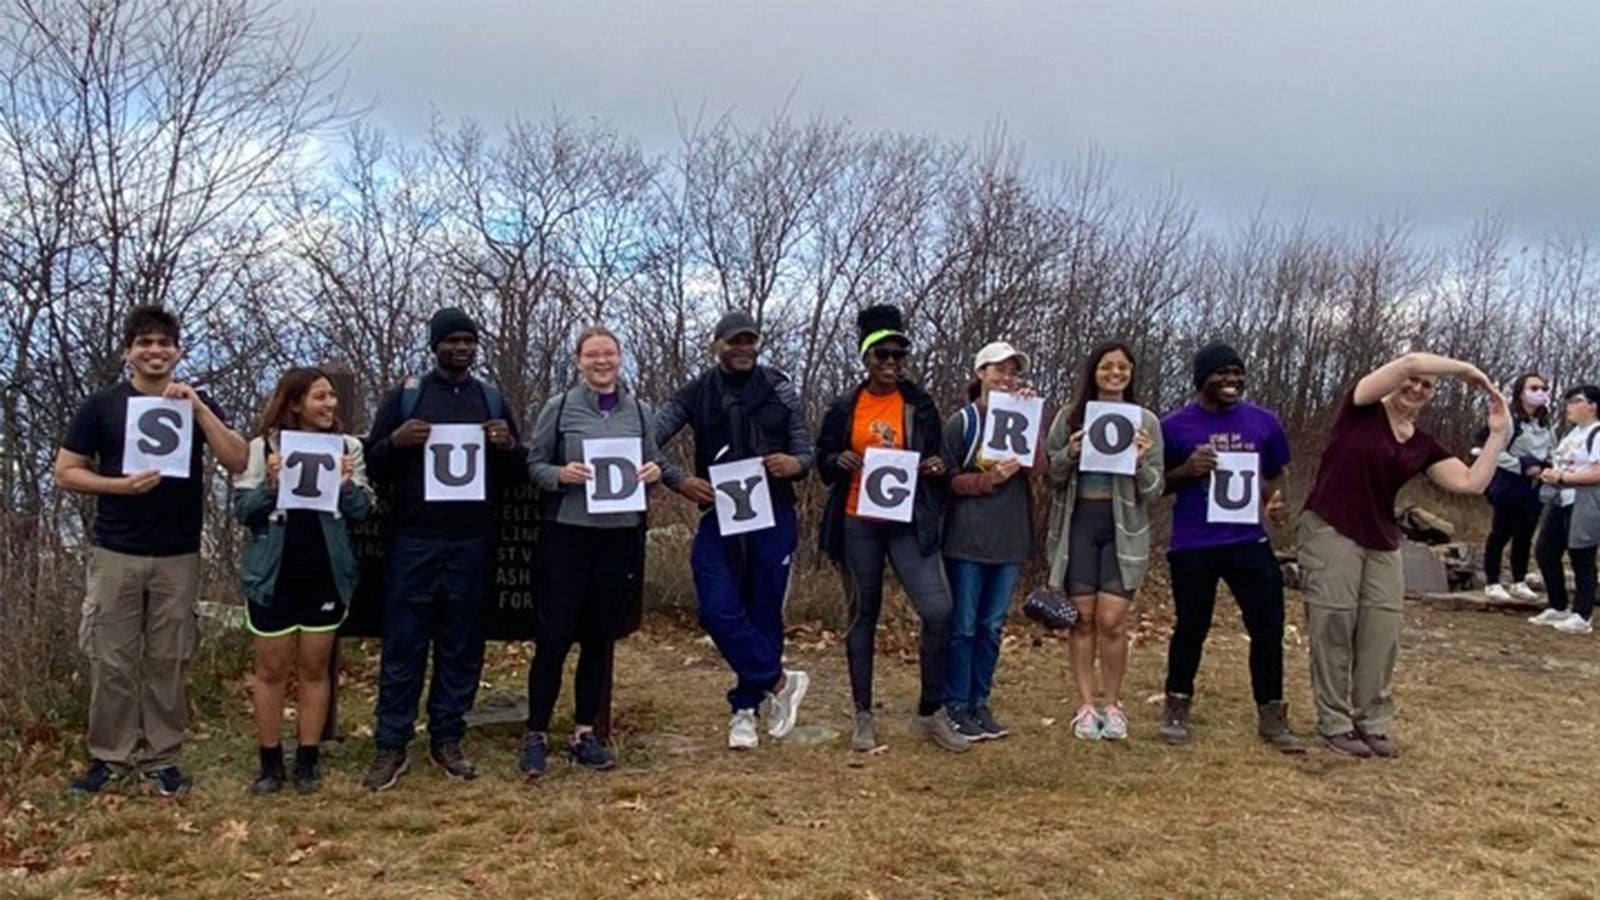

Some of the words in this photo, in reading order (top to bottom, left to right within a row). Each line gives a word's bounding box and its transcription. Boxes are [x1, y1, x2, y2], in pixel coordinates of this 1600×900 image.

[137, 408, 183, 456] S
[989, 409, 1030, 455] R
[1088, 414, 1136, 455] O
[285, 451, 336, 498] T
[429, 443, 481, 486] U
[590, 457, 639, 501] D
[716, 475, 763, 521] Y
[865, 466, 910, 508] G
[1213, 470, 1255, 509] U
[498, 590, 534, 609] FOR
